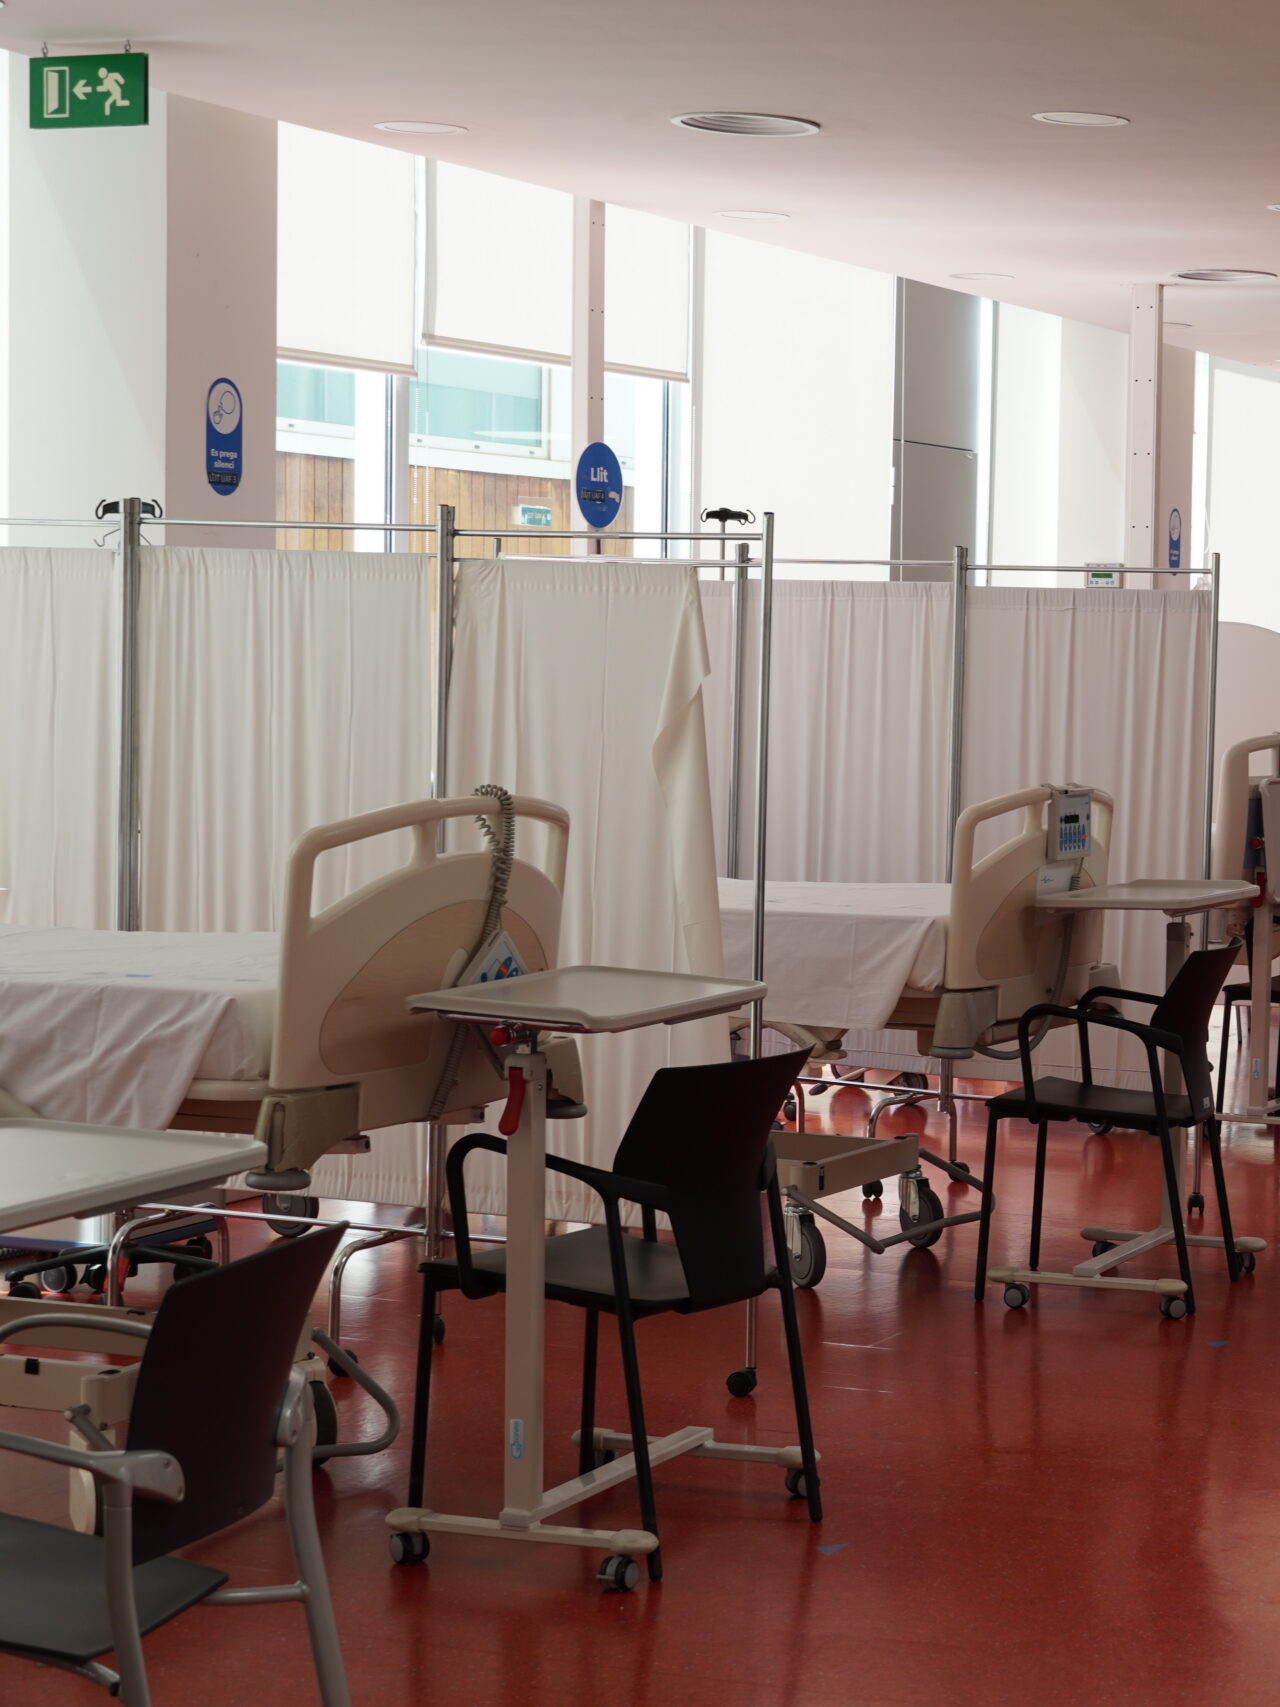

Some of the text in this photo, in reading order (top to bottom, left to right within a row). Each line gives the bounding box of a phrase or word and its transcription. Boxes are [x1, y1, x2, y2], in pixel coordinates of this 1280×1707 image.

[210, 448, 238, 460] Es prega
[214, 460, 235, 469] silenci
[591, 467, 608, 482] Llit
